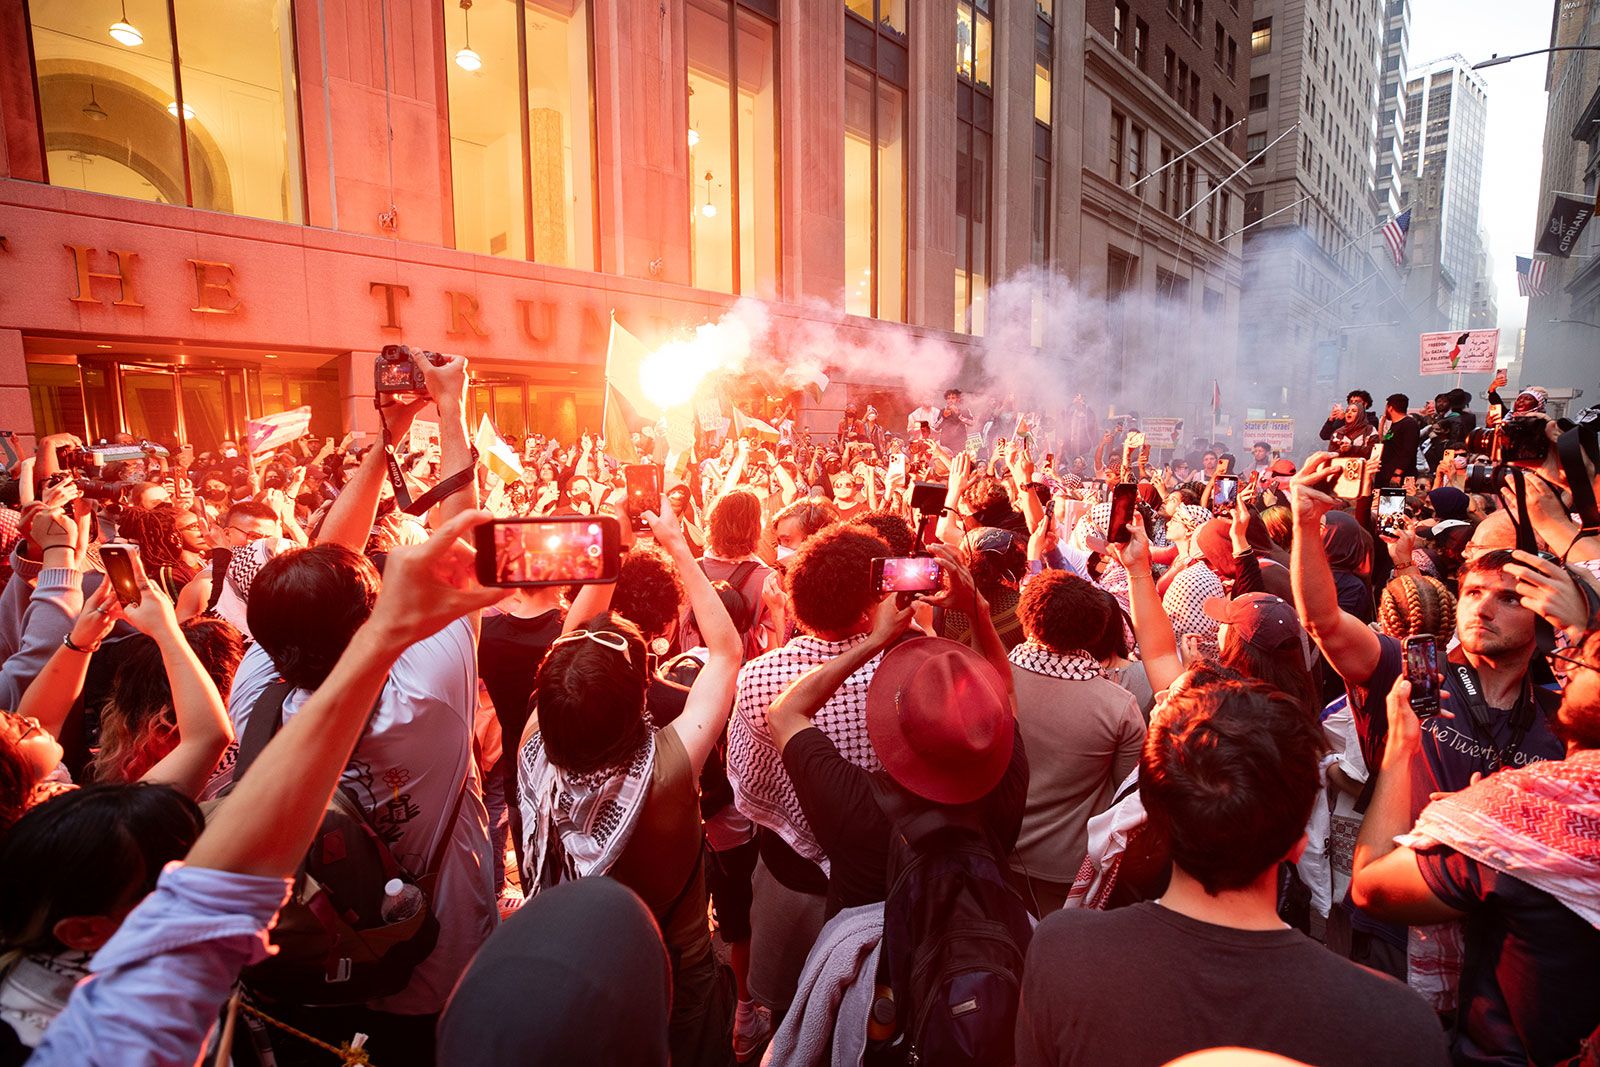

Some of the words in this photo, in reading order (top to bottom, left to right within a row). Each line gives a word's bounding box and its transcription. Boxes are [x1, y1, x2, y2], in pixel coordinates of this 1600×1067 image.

[1559, 209, 1589, 252] CIPRIANI
[1244, 422, 1261, 430] State
[1262, 421, 1268, 430] of
[1457, 666, 1477, 696] Canon
